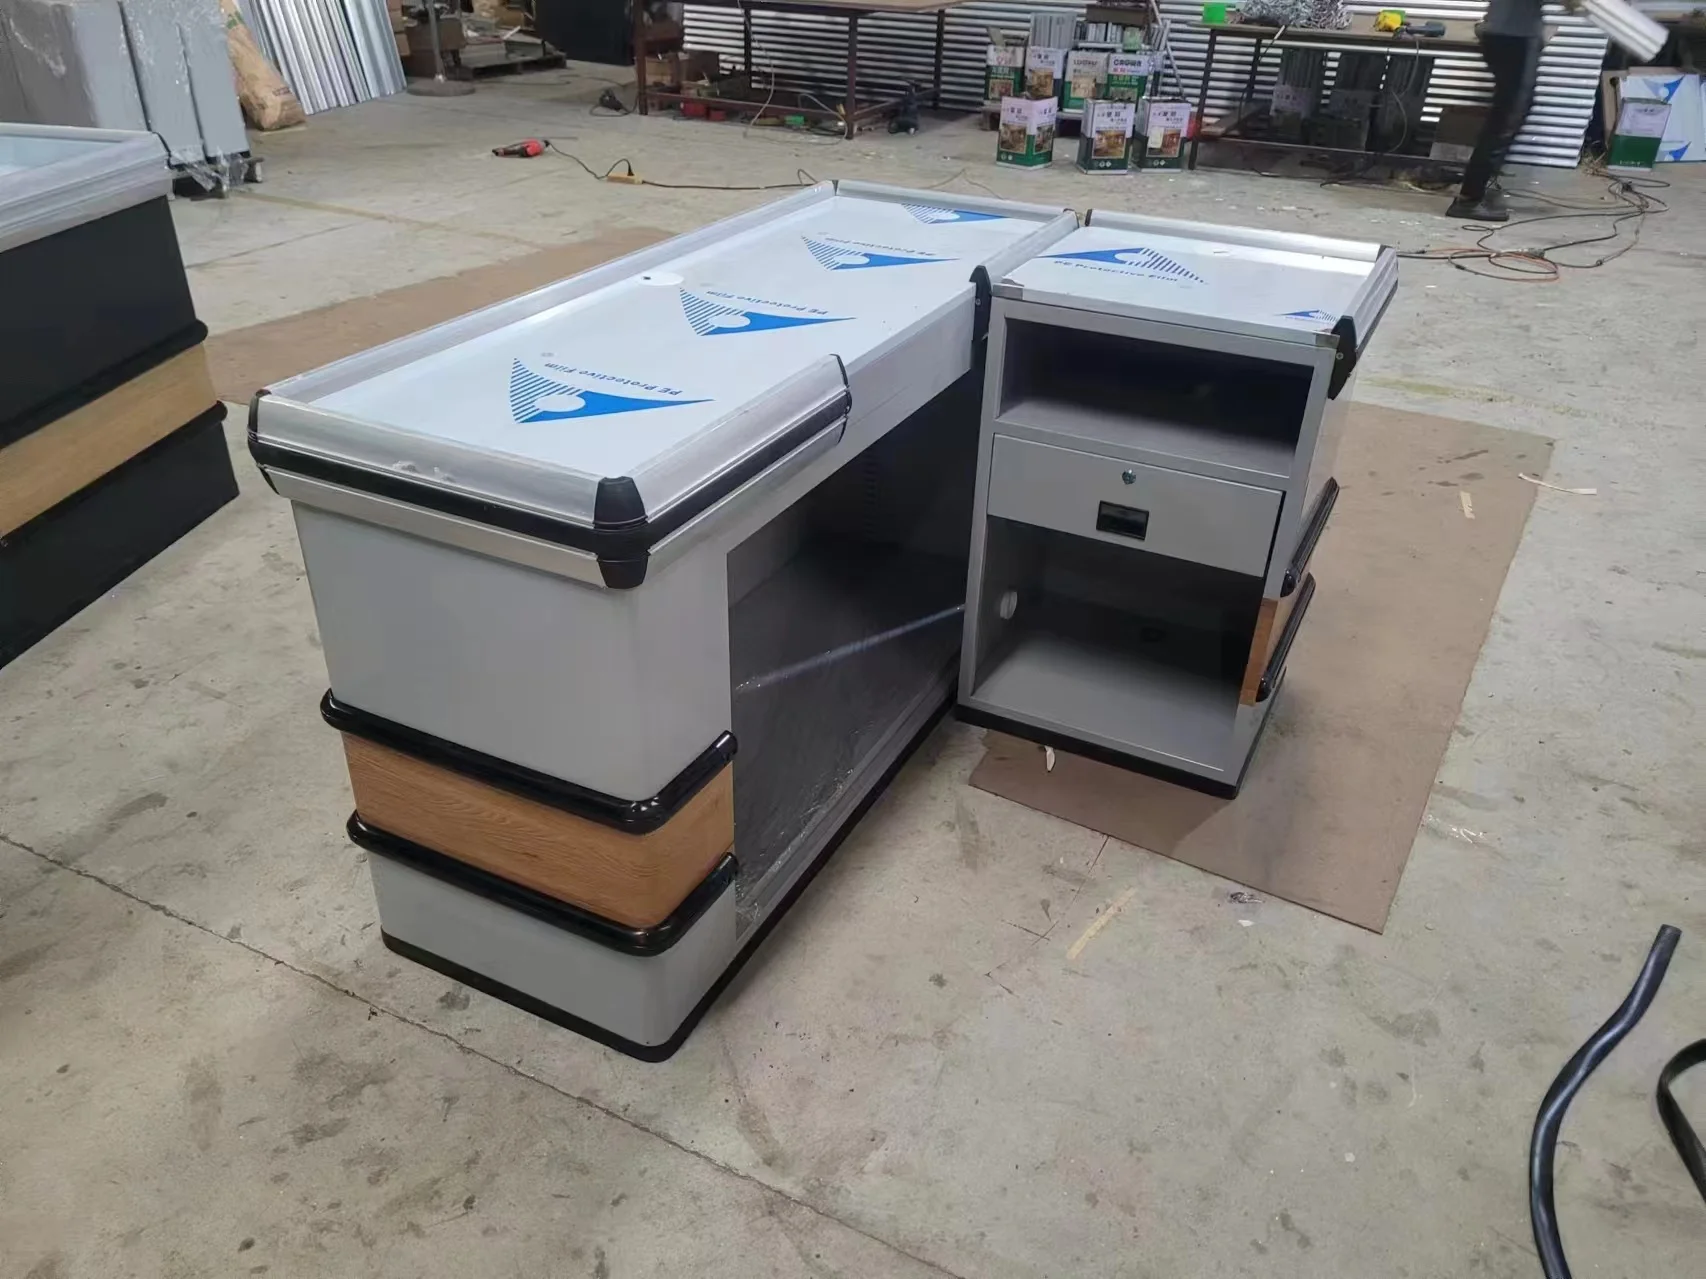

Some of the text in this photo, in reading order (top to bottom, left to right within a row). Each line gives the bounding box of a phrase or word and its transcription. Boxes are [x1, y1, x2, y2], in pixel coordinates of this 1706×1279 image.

[1075, 263, 1145, 277] Protective
[1148, 274, 1178, 282] Film
[706, 290, 829, 315] PE Protective Film
[544, 362, 683, 396] PE Protective Film
